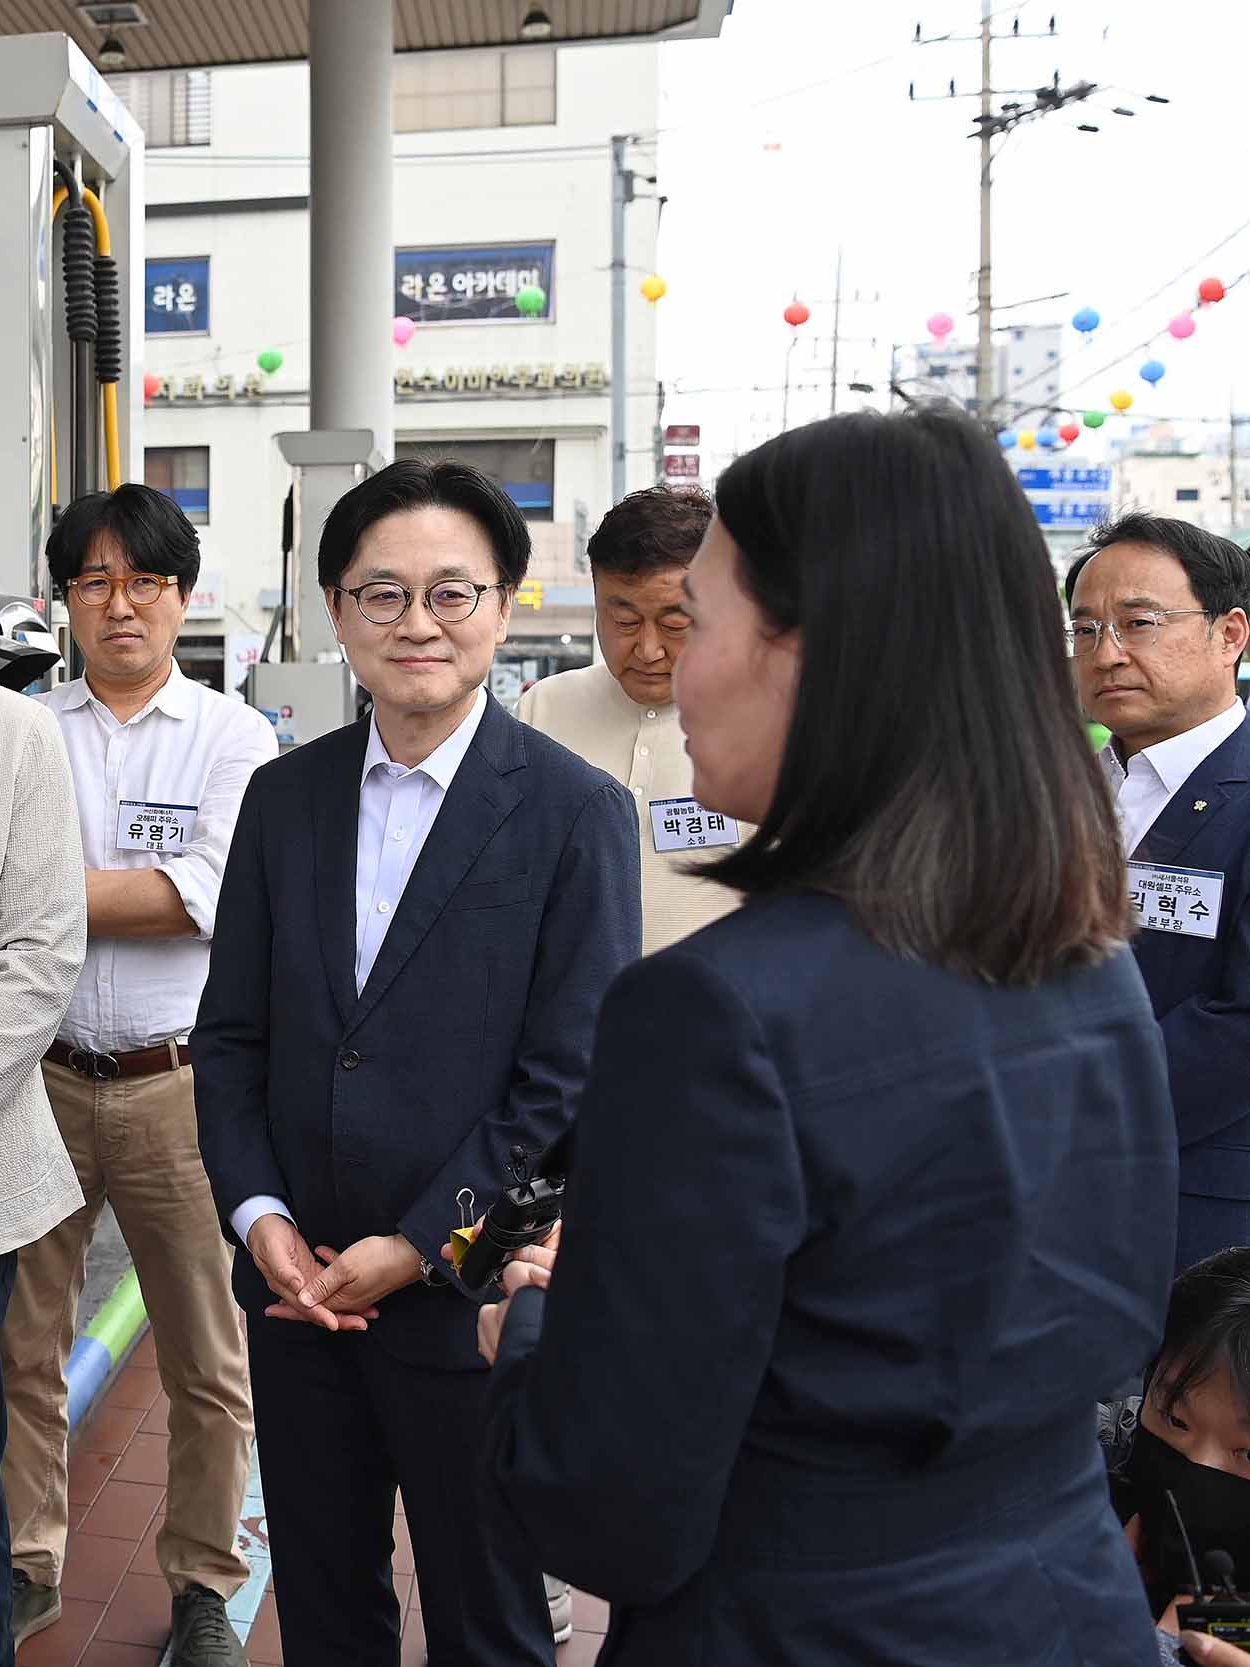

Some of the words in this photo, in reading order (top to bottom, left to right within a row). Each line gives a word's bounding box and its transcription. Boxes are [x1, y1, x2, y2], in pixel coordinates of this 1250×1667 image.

[452, 267, 540, 298] 아카데미
[153, 283, 197, 311] 라온
[158, 815, 179, 824] 주유소
[1174, 885, 1202, 897] 주유소
